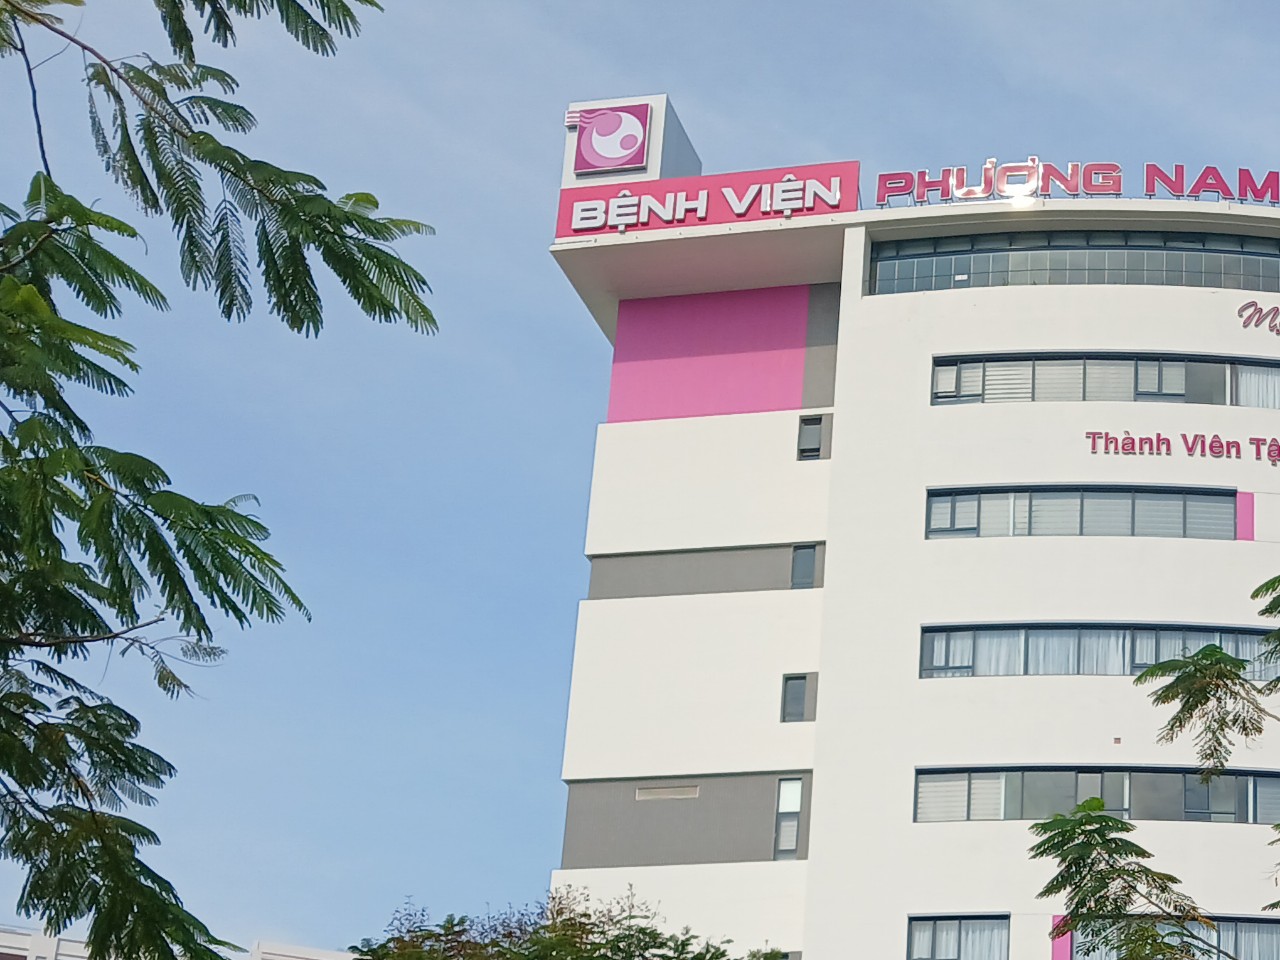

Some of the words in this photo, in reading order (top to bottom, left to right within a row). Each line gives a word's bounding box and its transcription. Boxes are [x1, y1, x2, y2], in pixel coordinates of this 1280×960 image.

[571, 190, 708, 233] BỆNH
[721, 174, 841, 218] VIỆN
[876, 156, 1123, 205] PHƯƠNG
[1144, 163, 1280, 203] NAM
[1085, 431, 1172, 456] Thành
[1180, 433, 1242, 459] Viên
